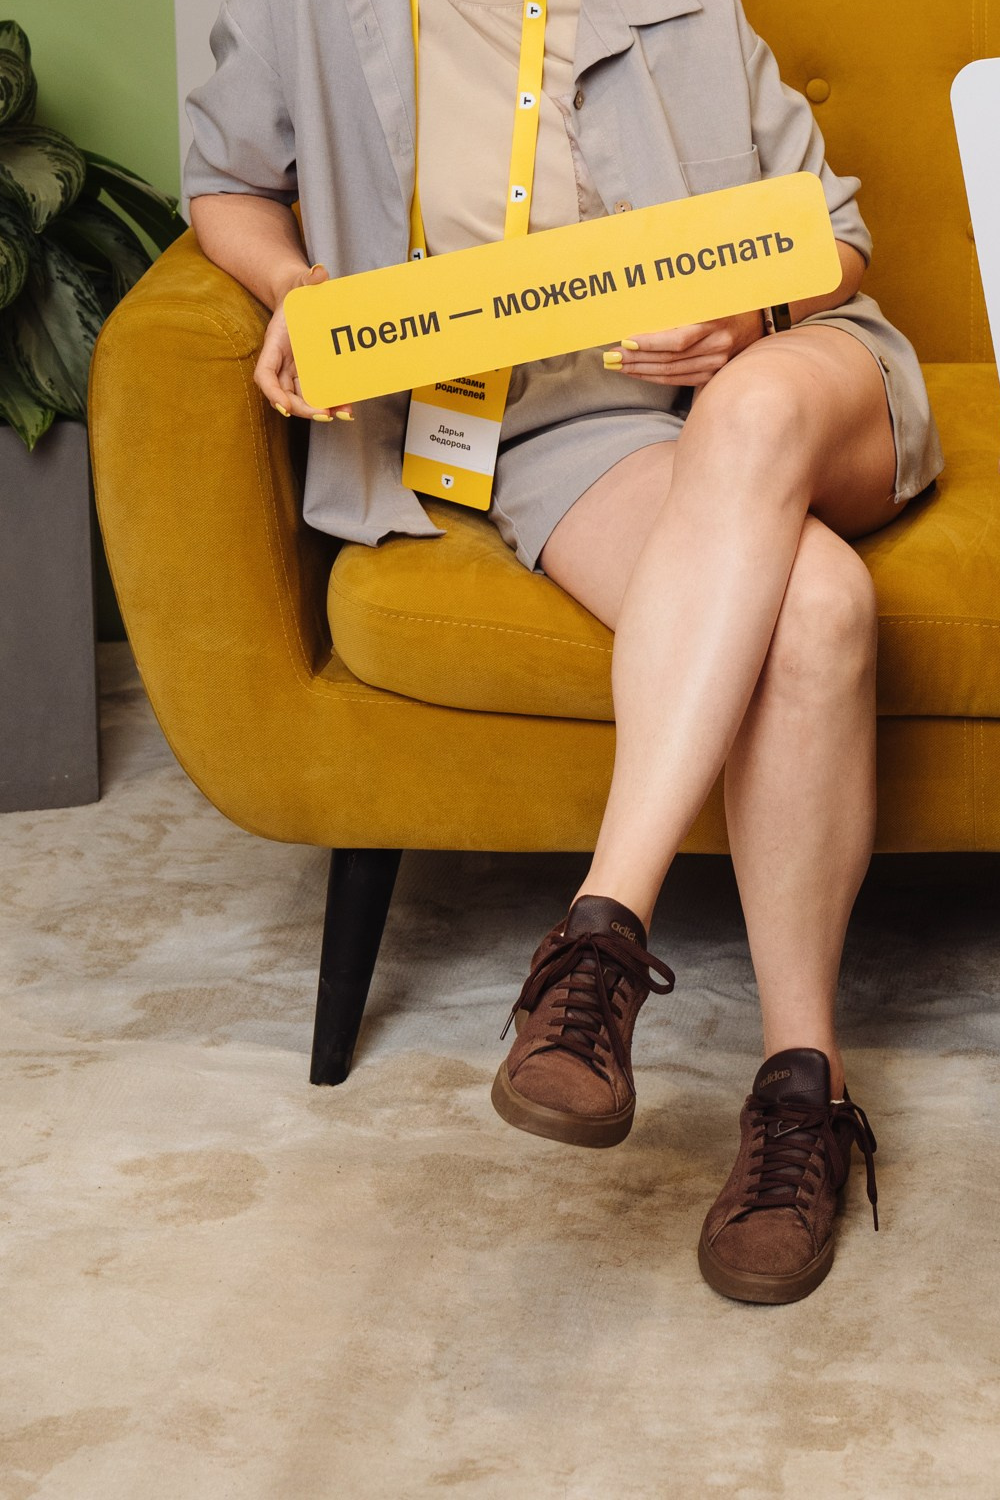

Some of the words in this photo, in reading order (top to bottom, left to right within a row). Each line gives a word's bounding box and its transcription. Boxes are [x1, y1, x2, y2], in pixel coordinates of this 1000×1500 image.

[330, 311, 441, 356] Поели
[492, 270, 618, 319] можем
[623, 263, 647, 288] и
[653, 231, 795, 282] поспать
[435, 382, 486, 401] родителей
[450, 377, 486, 389] азами
[438, 425, 465, 438] Дарья
[429, 434, 471, 451] Федорова
[611, 921, 638, 945] adid
